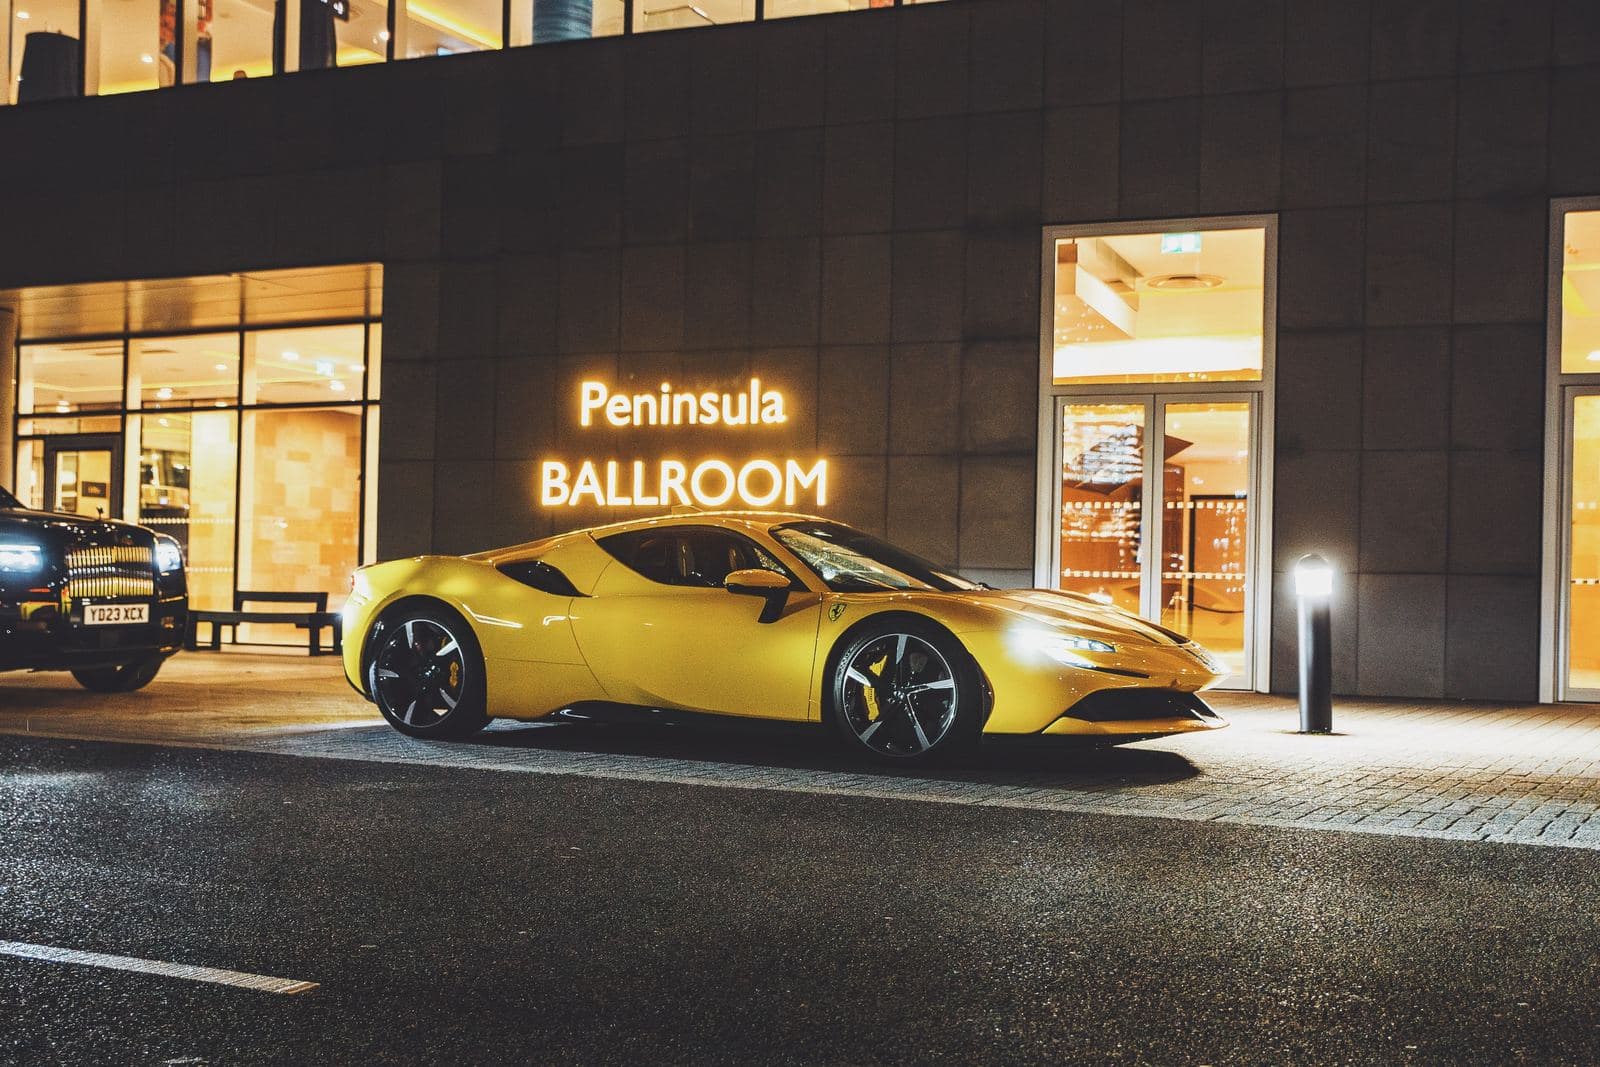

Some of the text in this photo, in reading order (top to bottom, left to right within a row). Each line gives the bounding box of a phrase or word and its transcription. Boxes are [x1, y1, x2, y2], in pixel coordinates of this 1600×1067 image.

[579, 377, 788, 426] Peninsula
[541, 459, 828, 506] BALLROOM
[90, 607, 144, 621] YD23 XCX
